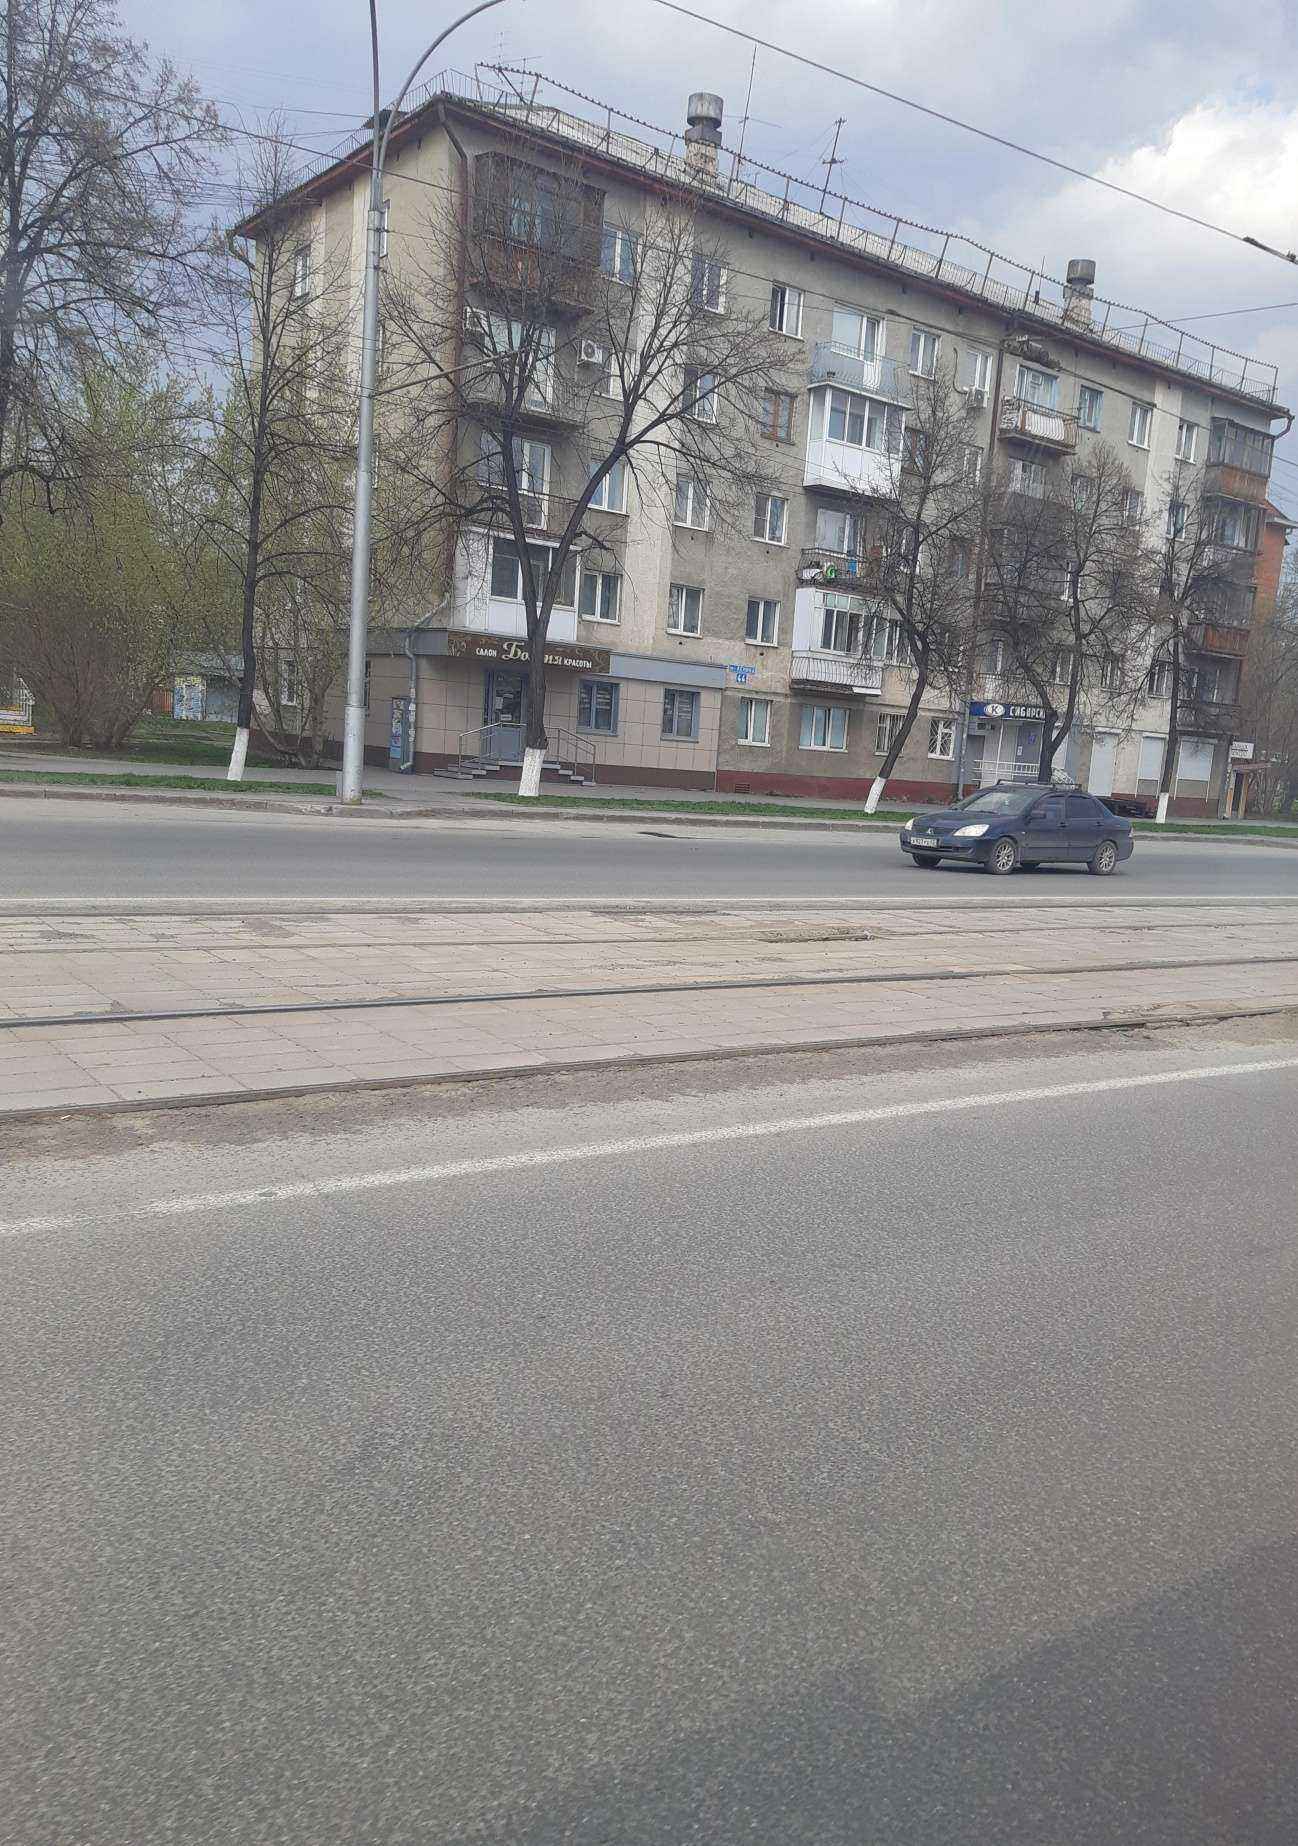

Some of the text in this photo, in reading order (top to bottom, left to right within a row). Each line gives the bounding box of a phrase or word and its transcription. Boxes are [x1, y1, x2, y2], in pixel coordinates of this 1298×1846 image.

[475, 647, 497, 657] САЛОН
[563, 657, 592, 669] КРАСОТЫ
[1009, 706, 1046, 719] СИБИРСК
